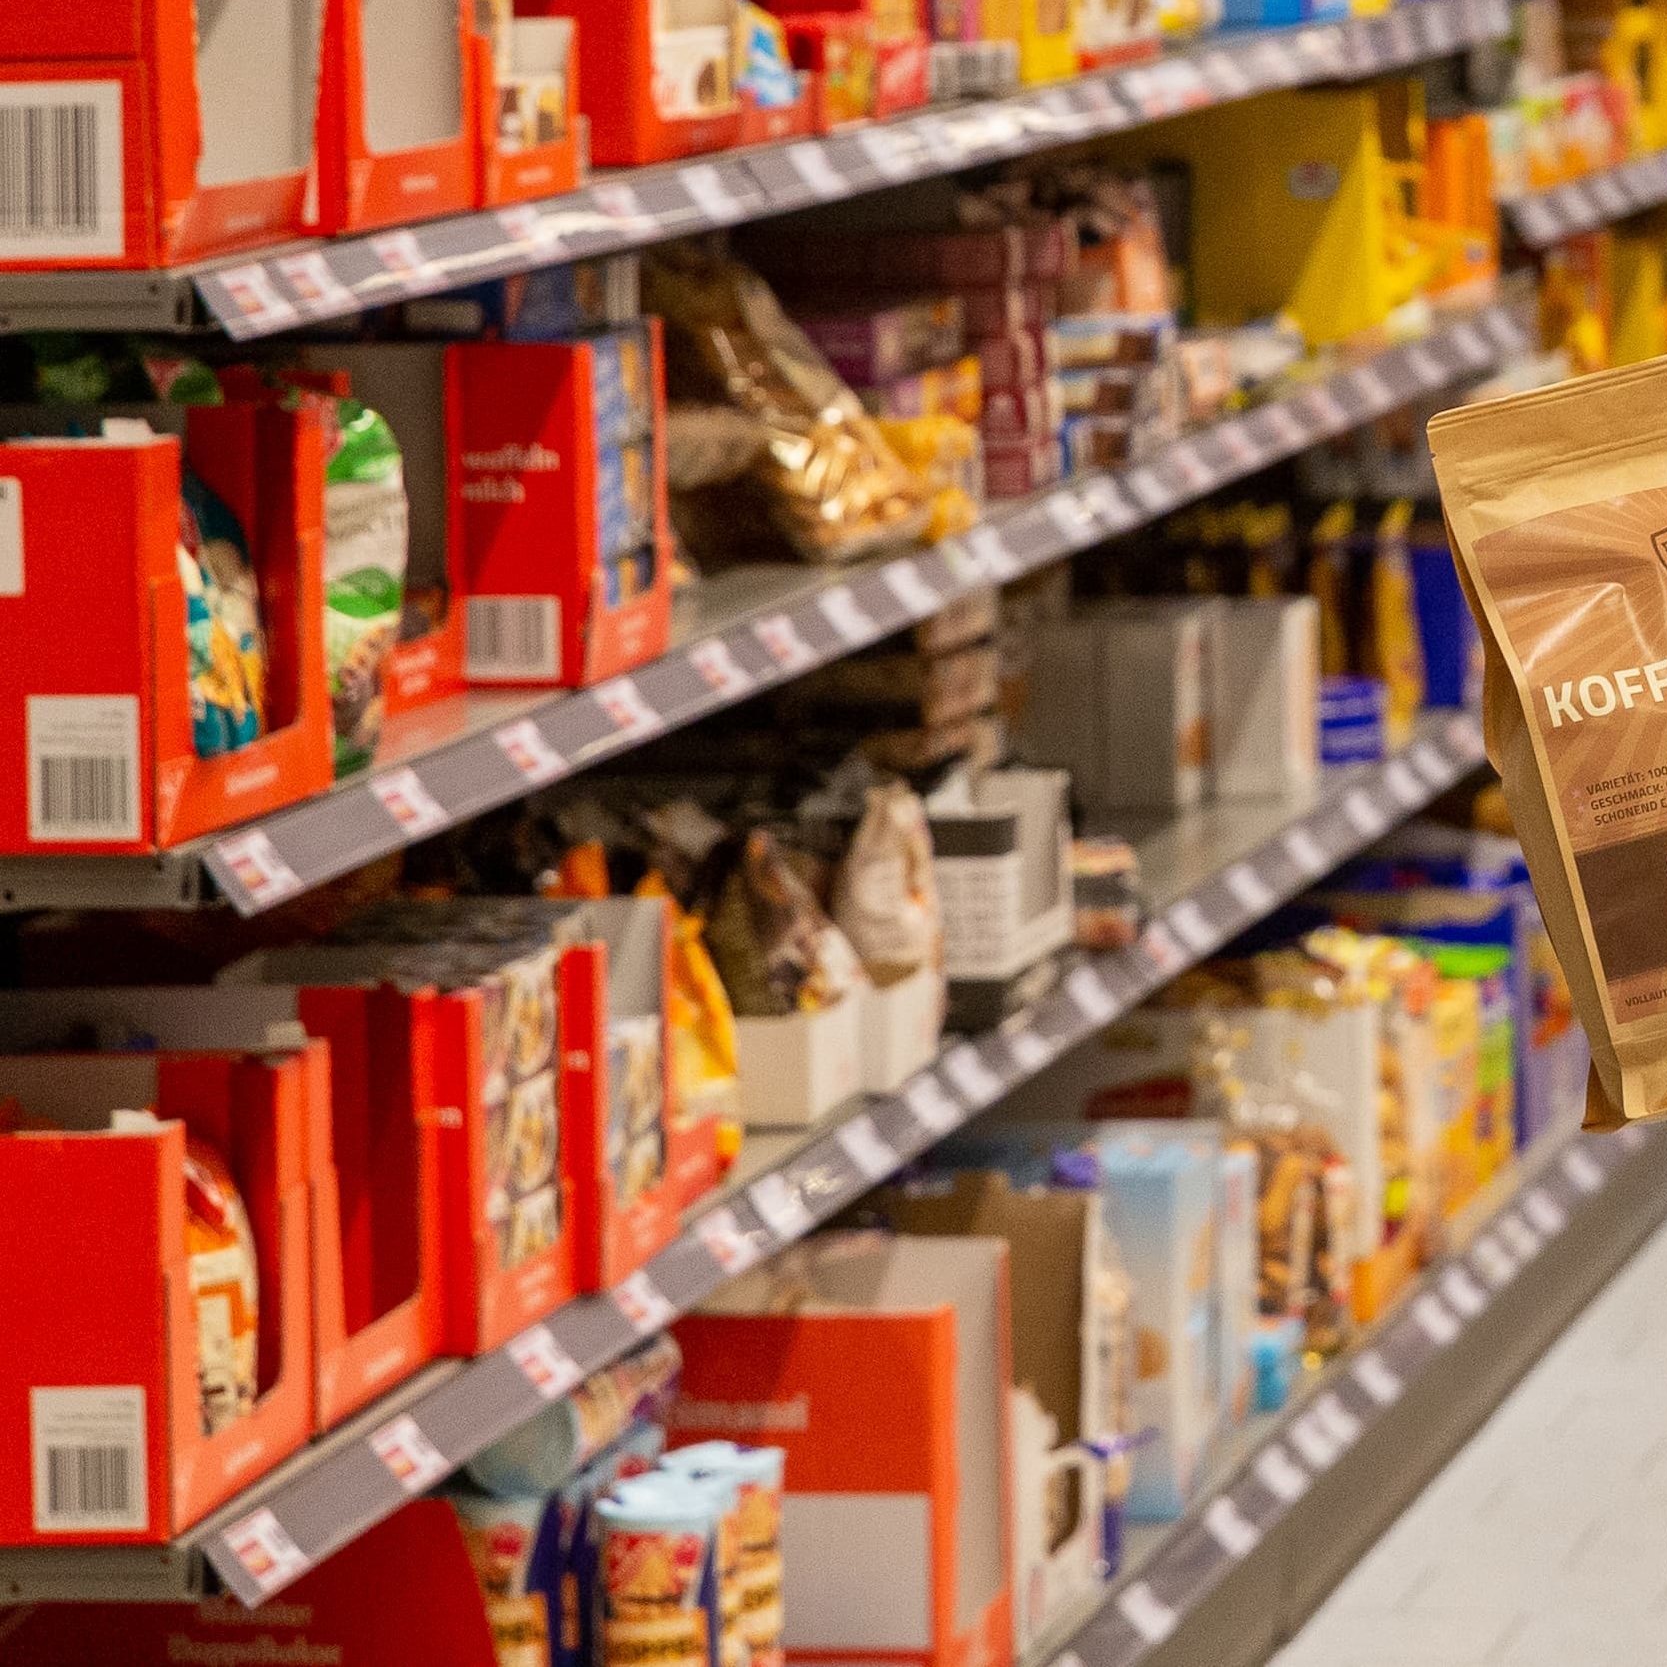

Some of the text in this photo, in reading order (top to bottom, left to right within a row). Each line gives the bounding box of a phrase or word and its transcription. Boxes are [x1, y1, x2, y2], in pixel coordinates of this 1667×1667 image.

[1586, 772, 1646, 796] VARIETÄT:
[1590, 784, 1665, 811] GESCHMACK:
[1594, 801, 1658, 826] SCHONEND
